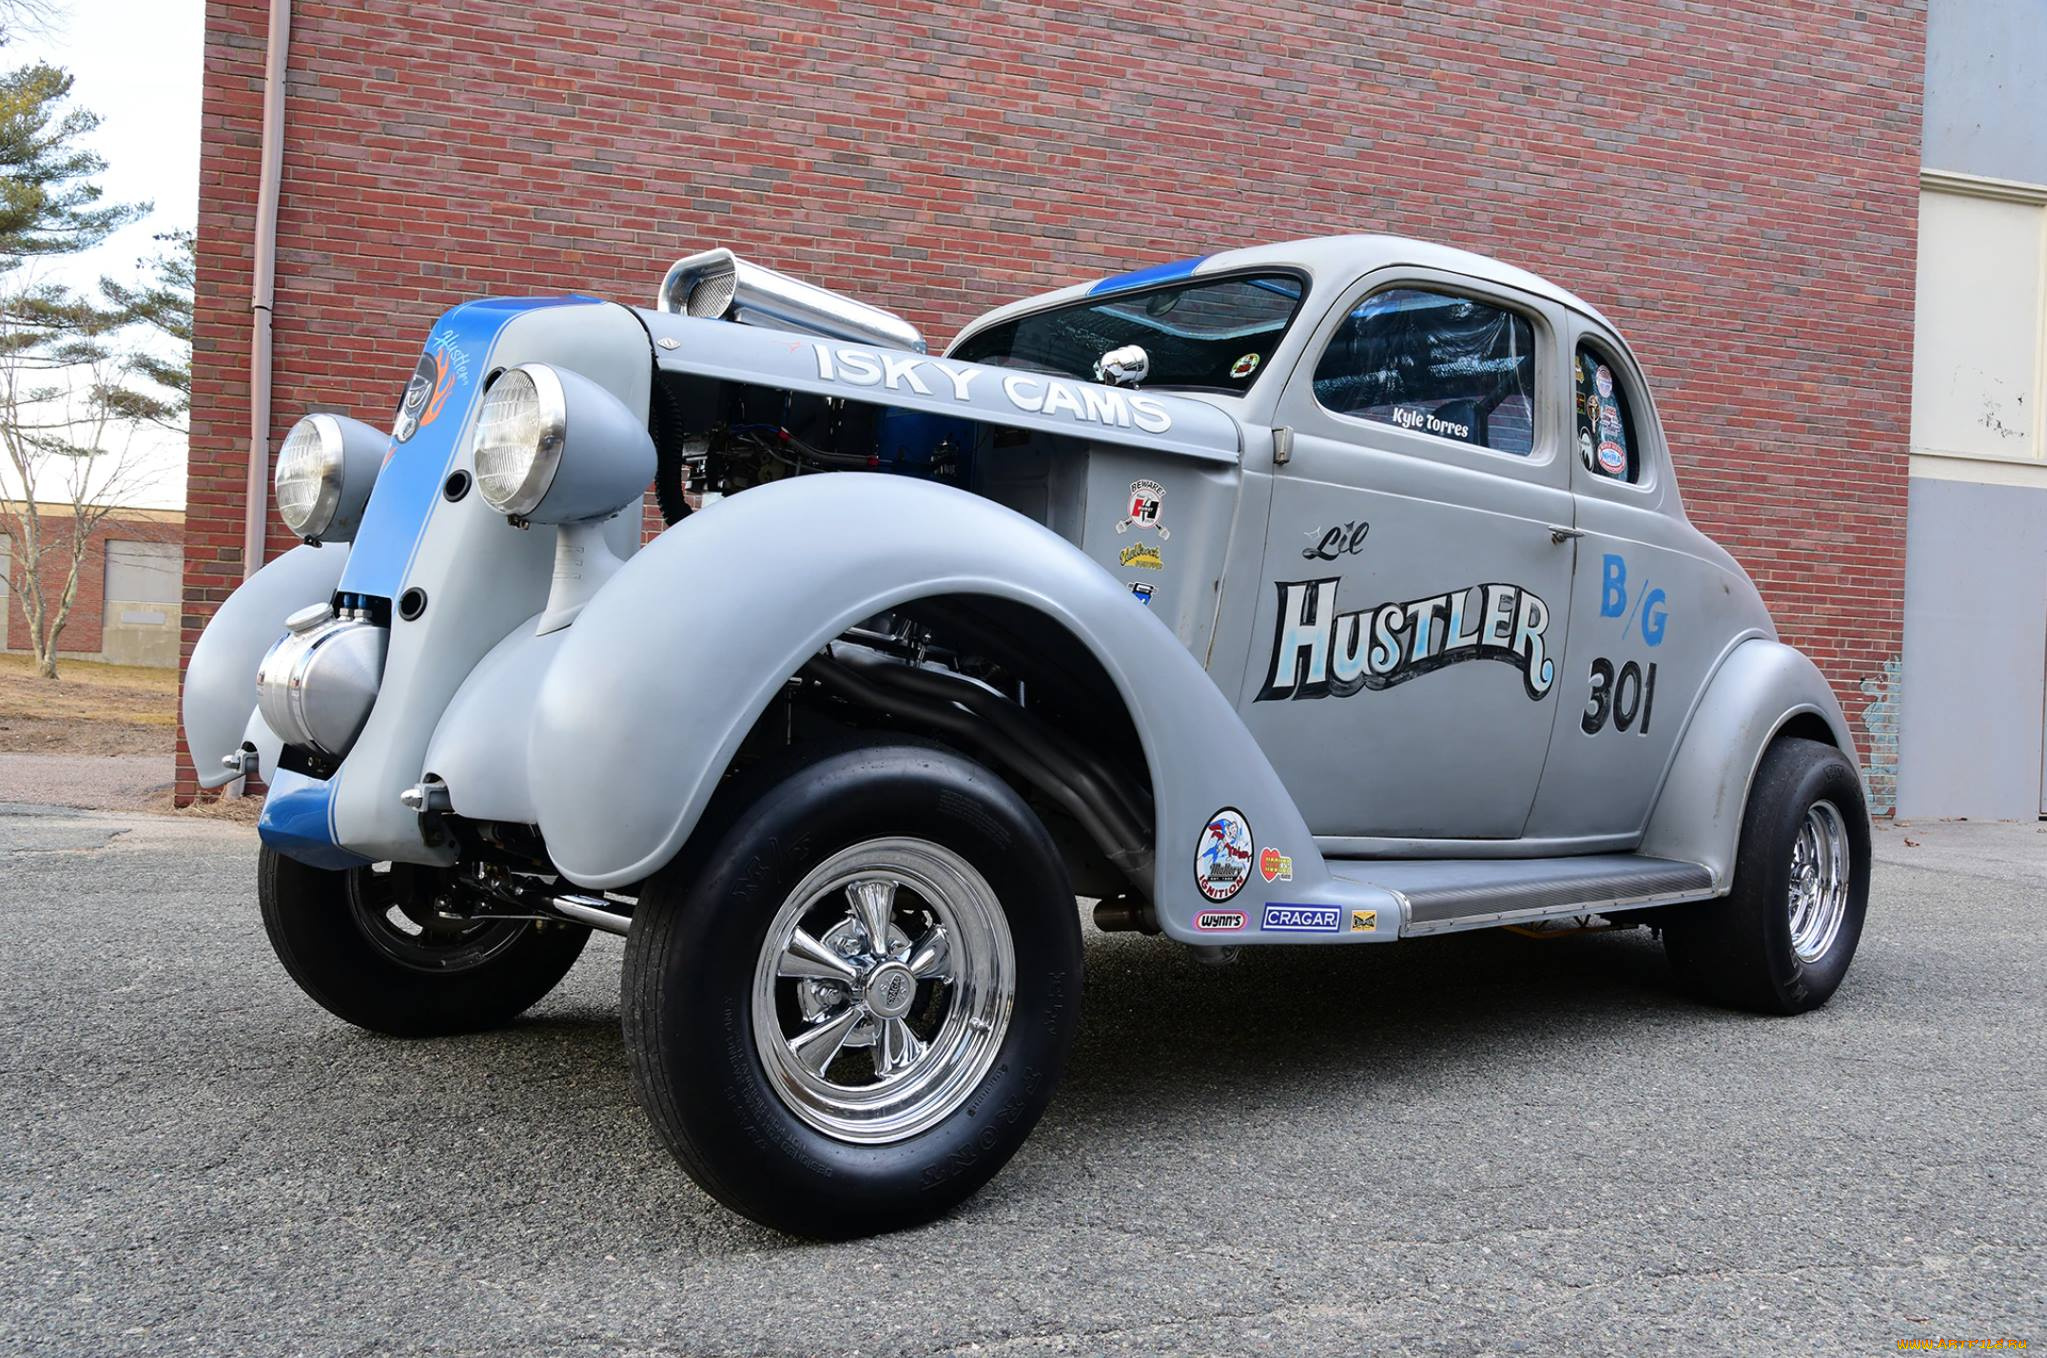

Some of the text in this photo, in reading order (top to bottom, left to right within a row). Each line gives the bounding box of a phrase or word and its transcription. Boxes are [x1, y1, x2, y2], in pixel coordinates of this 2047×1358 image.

[811, 343, 1173, 434] ISKY CAMS
[1392, 407, 1469, 438] Kyle Torres
[1302, 519, 1370, 561] Lil
[1600, 554, 1669, 648] B/G
[1252, 576, 1555, 703] HUSTLER
[1579, 656, 1658, 737] 301
[1199, 874, 1244, 898] IGNITION
[1267, 910, 1337, 927] CRAGAR
